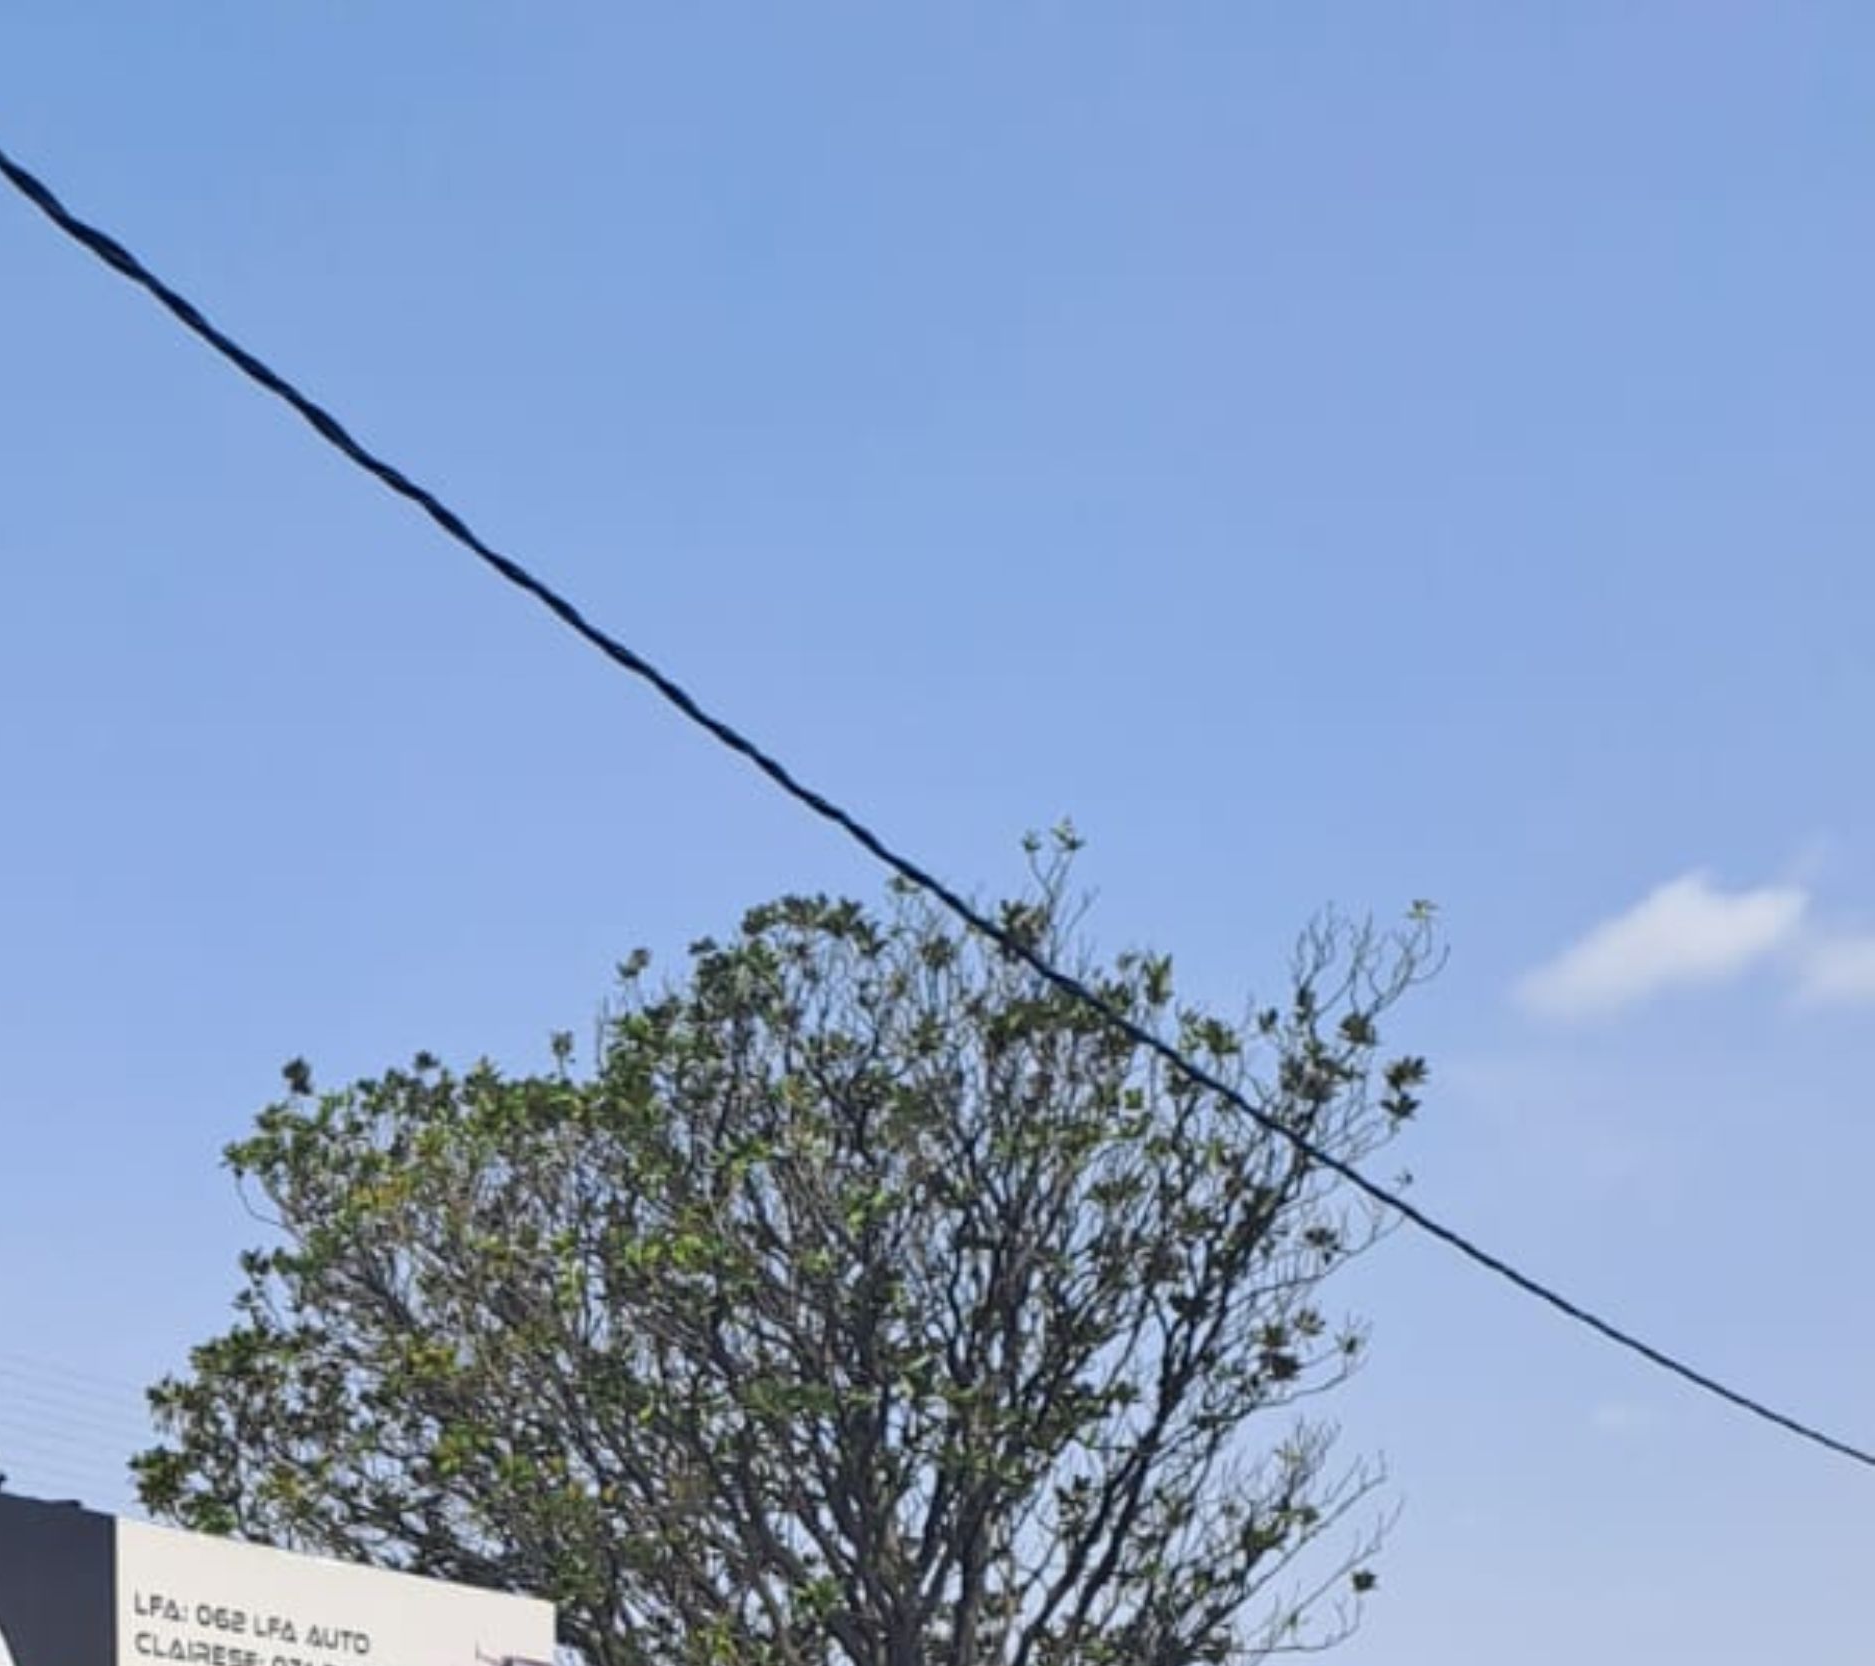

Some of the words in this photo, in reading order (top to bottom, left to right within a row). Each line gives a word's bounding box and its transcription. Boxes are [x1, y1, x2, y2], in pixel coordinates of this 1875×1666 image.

[134, 1590, 188, 1622] LFA:
[196, 1604, 246, 1634] 062
[254, 1615, 298, 1643] LFA
[305, 1624, 370, 1656] AUTO
